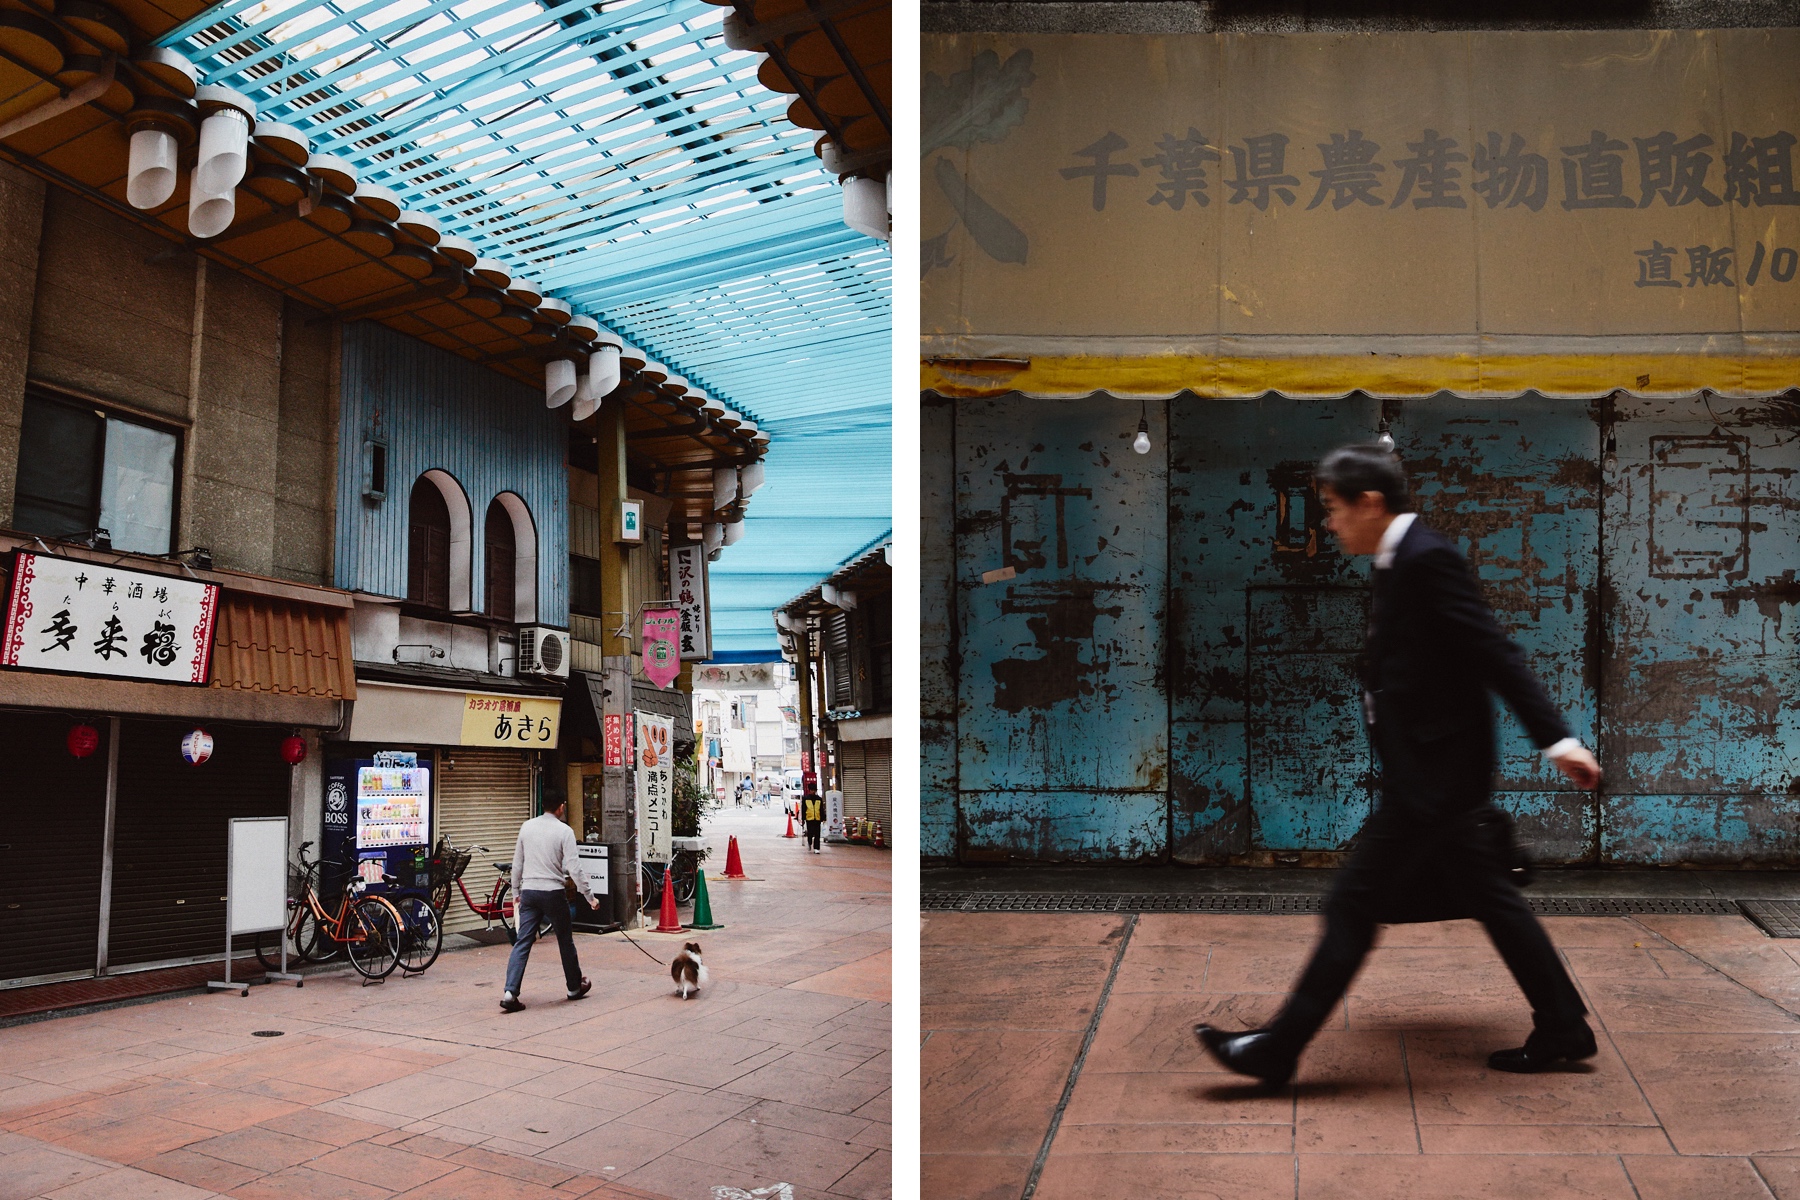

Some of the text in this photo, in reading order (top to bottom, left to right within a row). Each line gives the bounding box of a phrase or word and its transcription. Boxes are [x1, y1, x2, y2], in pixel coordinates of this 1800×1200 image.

[1058, 127, 1800, 212] 千葉県農産物直販組
[1633, 240, 1799, 288] 直販10
[75, 572, 168, 603] 中華酒場
[678, 566, 695, 605] 沢の鶴
[41, 609, 182, 666] 多来福
[468, 698, 521, 713] カラオケ居酒屋
[494, 713, 552, 742] あきら
[605, 716, 613, 765] ポイントカード
[328, 781, 346, 791] COFFEE
[325, 812, 348, 824] BOSS
[647, 770, 659, 845] 満点メニュー
